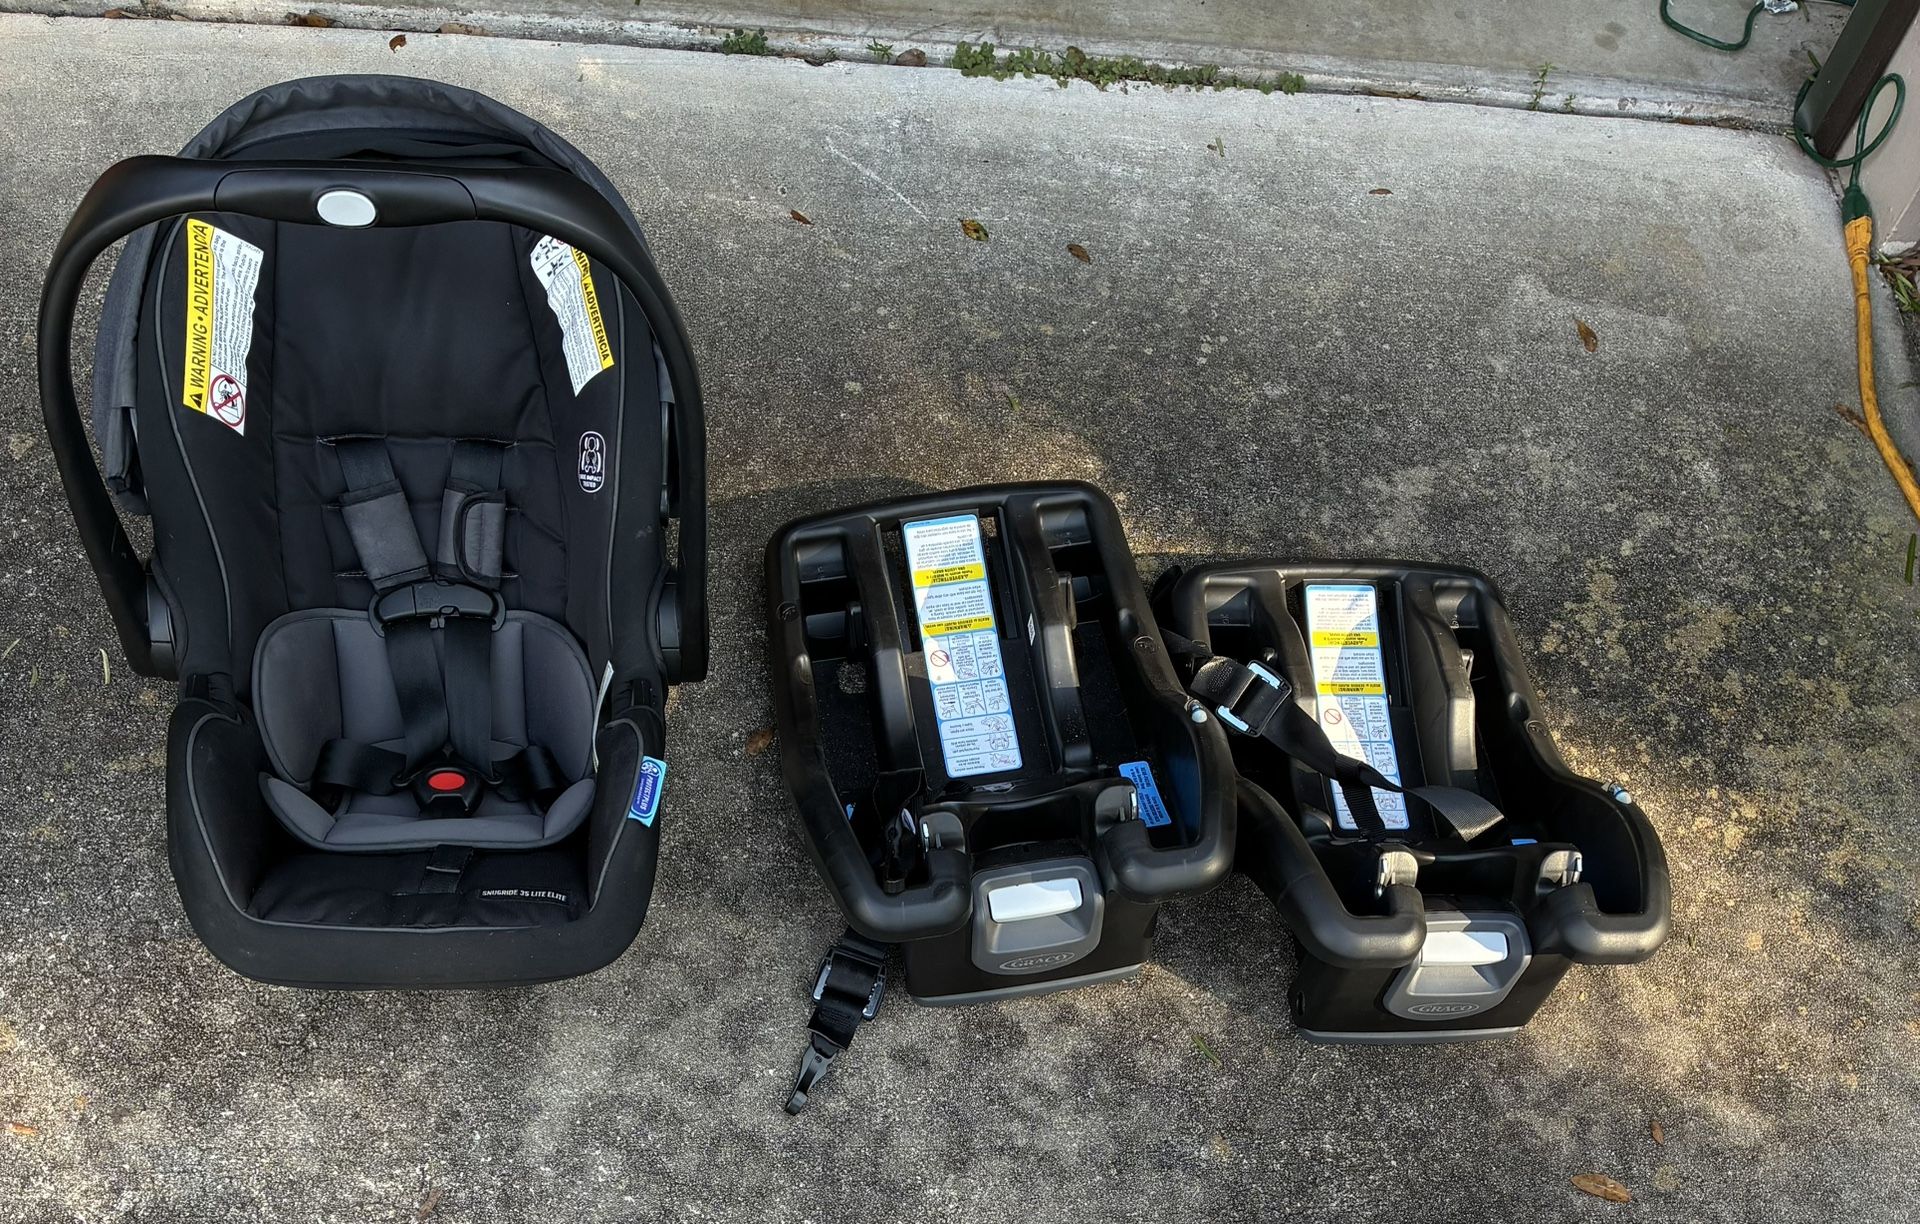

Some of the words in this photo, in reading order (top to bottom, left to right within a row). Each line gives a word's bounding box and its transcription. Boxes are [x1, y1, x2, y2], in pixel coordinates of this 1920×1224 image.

[193, 224, 209, 316] ADVERTENCIA
[585, 290, 610, 361] ADVERTENCIA
[190, 321, 208, 389] WARNING
[640, 774, 654, 811] PROTECTPLUS
[519, 889, 530, 897] 35
[530, 890, 546, 898] LITE
[546, 891, 566, 901] ELITE
[1010, 953, 1068, 968] GRACO
[1418, 1003, 1474, 1014] GRACO
